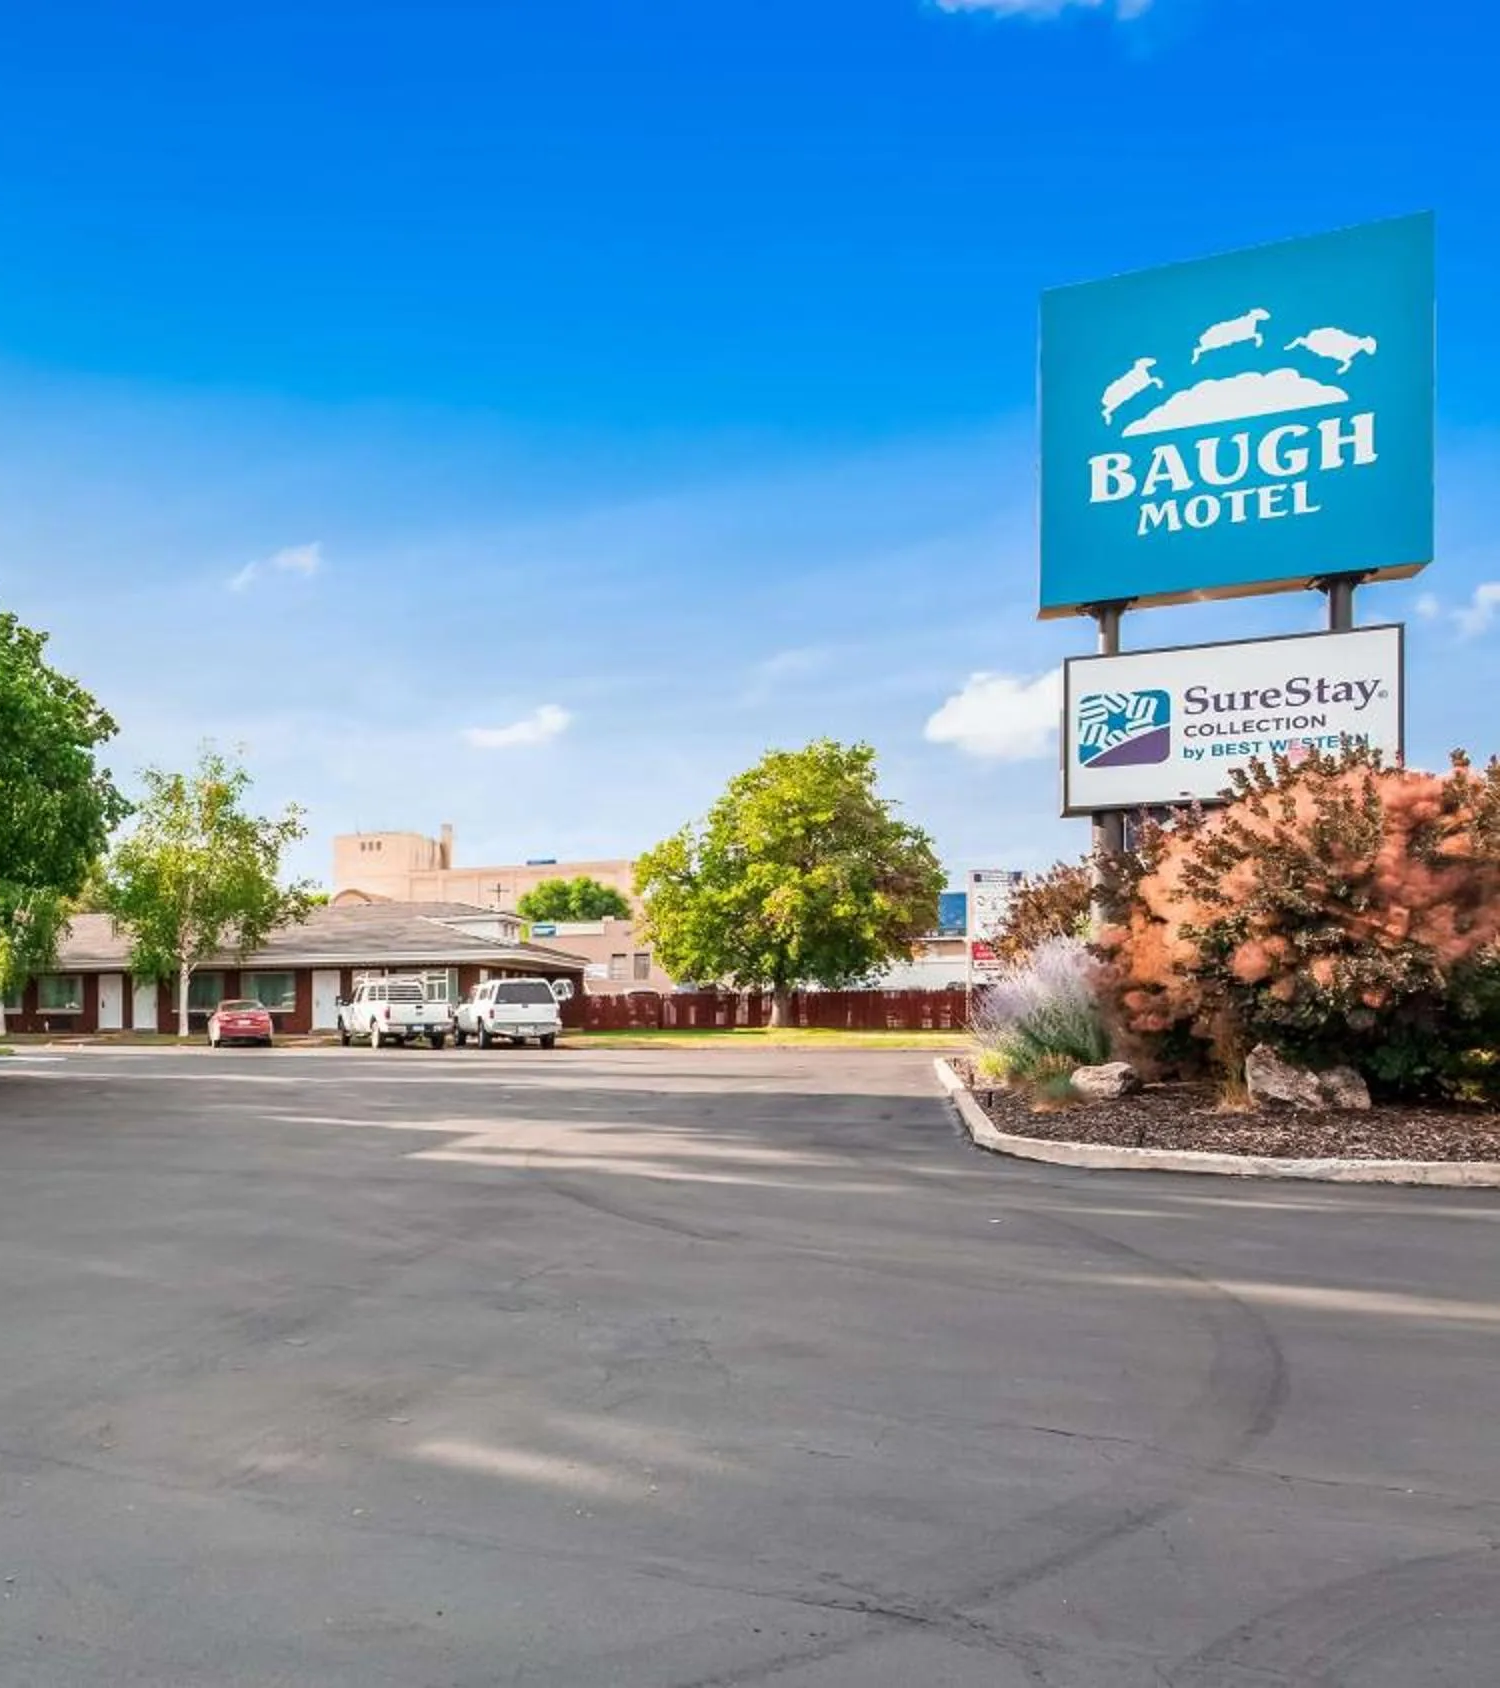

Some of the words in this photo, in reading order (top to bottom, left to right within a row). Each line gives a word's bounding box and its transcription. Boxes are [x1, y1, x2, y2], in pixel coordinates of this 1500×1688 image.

[1088, 412, 1378, 502] BAUGH
[1137, 481, 1321, 536] MOTEL
[1183, 714, 1327, 738] COLLECTION
[1183, 746, 1205, 760] by
[1211, 741, 1263, 757] BEST
